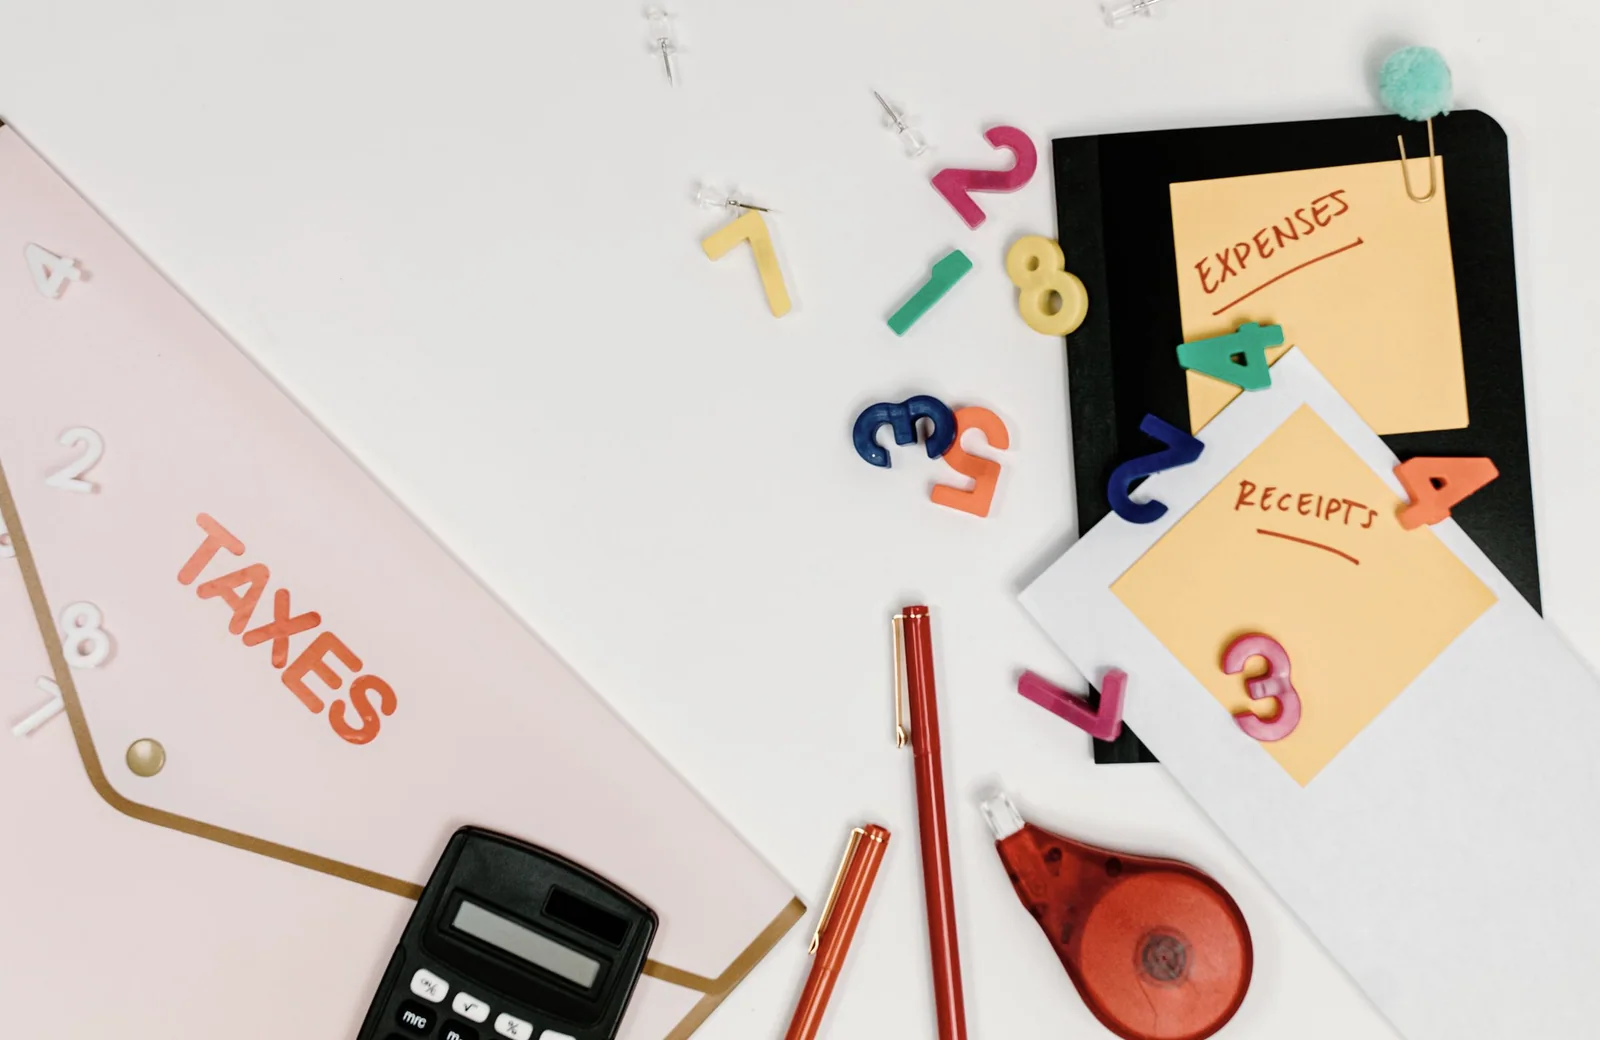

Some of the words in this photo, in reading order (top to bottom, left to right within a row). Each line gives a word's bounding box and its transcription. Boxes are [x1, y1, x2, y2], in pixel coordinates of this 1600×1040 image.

[933, 125, 1037, 229] 2
[26, 242, 80, 297] 4
[701, 209, 792, 318] 7
[1195, 189, 1349, 294] EXPENSES
[887, 249, 973, 336] 1
[1006, 235, 1089, 336] 8
[1176, 322, 1284, 390] 4
[45, 426, 104, 494] 2
[853, 395, 957, 468] 3
[930, 406, 1009, 518] 5
[1107, 413, 1205, 524] 2
[1234, 480, 1378, 529] RECEIPTS
[1393, 456, 1500, 531] 4
[60, 601, 110, 669] 8
[177, 512, 398, 745] TAXES
[1017, 668, 1128, 742] 7
[1220, 633, 1302, 742] 3
[402, 1010, 427, 1029] mrc
